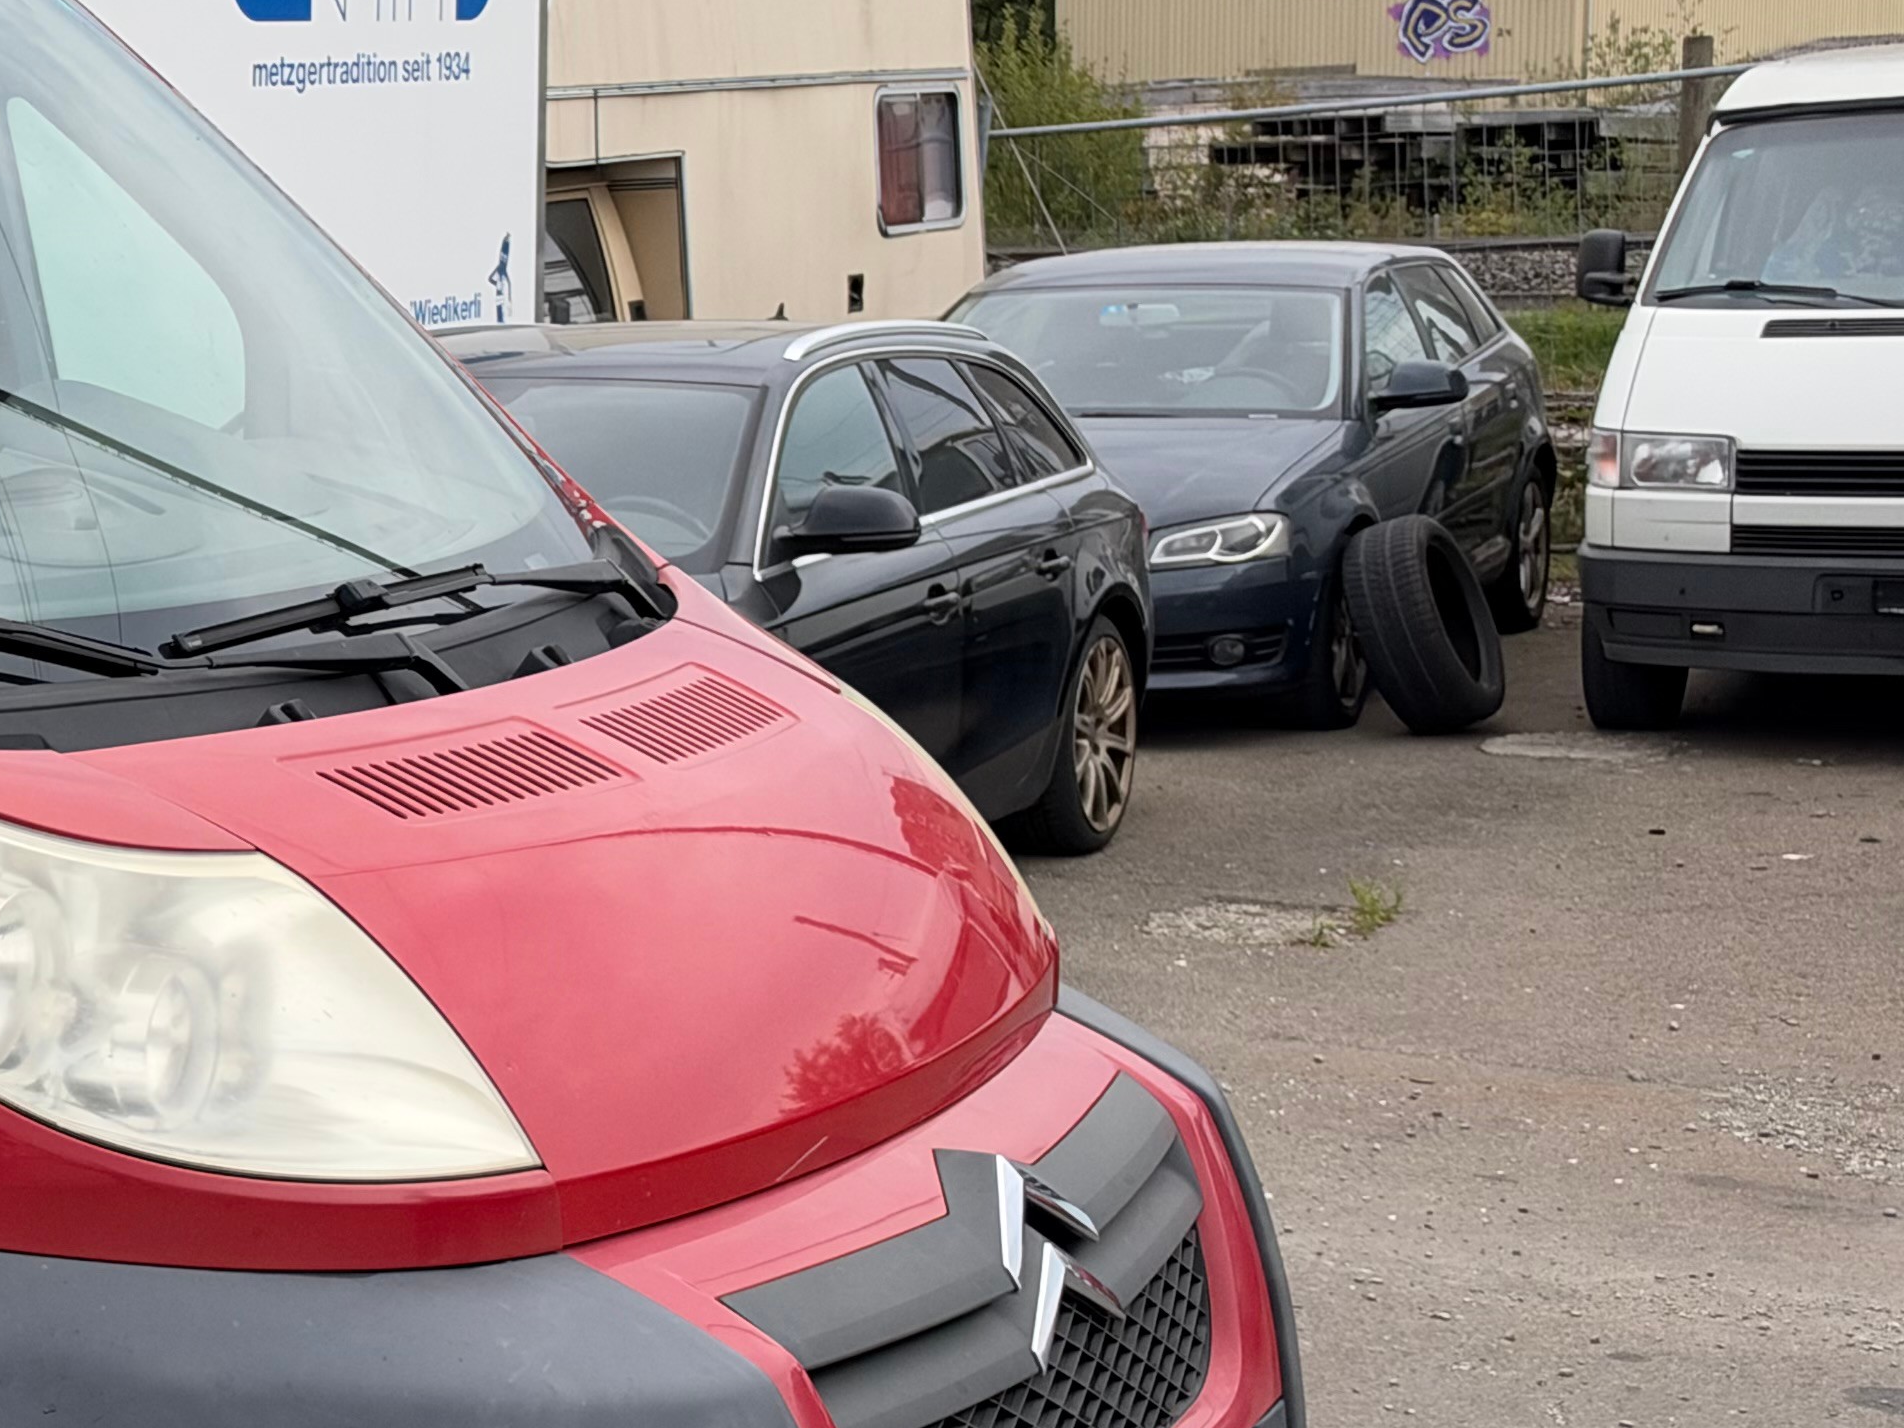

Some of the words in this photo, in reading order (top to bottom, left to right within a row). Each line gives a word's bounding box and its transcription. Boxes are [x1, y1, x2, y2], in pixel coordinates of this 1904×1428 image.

[252, 53, 398, 94] metzgertradition
[402, 53, 432, 82] seit
[435, 52, 471, 82] 1934
